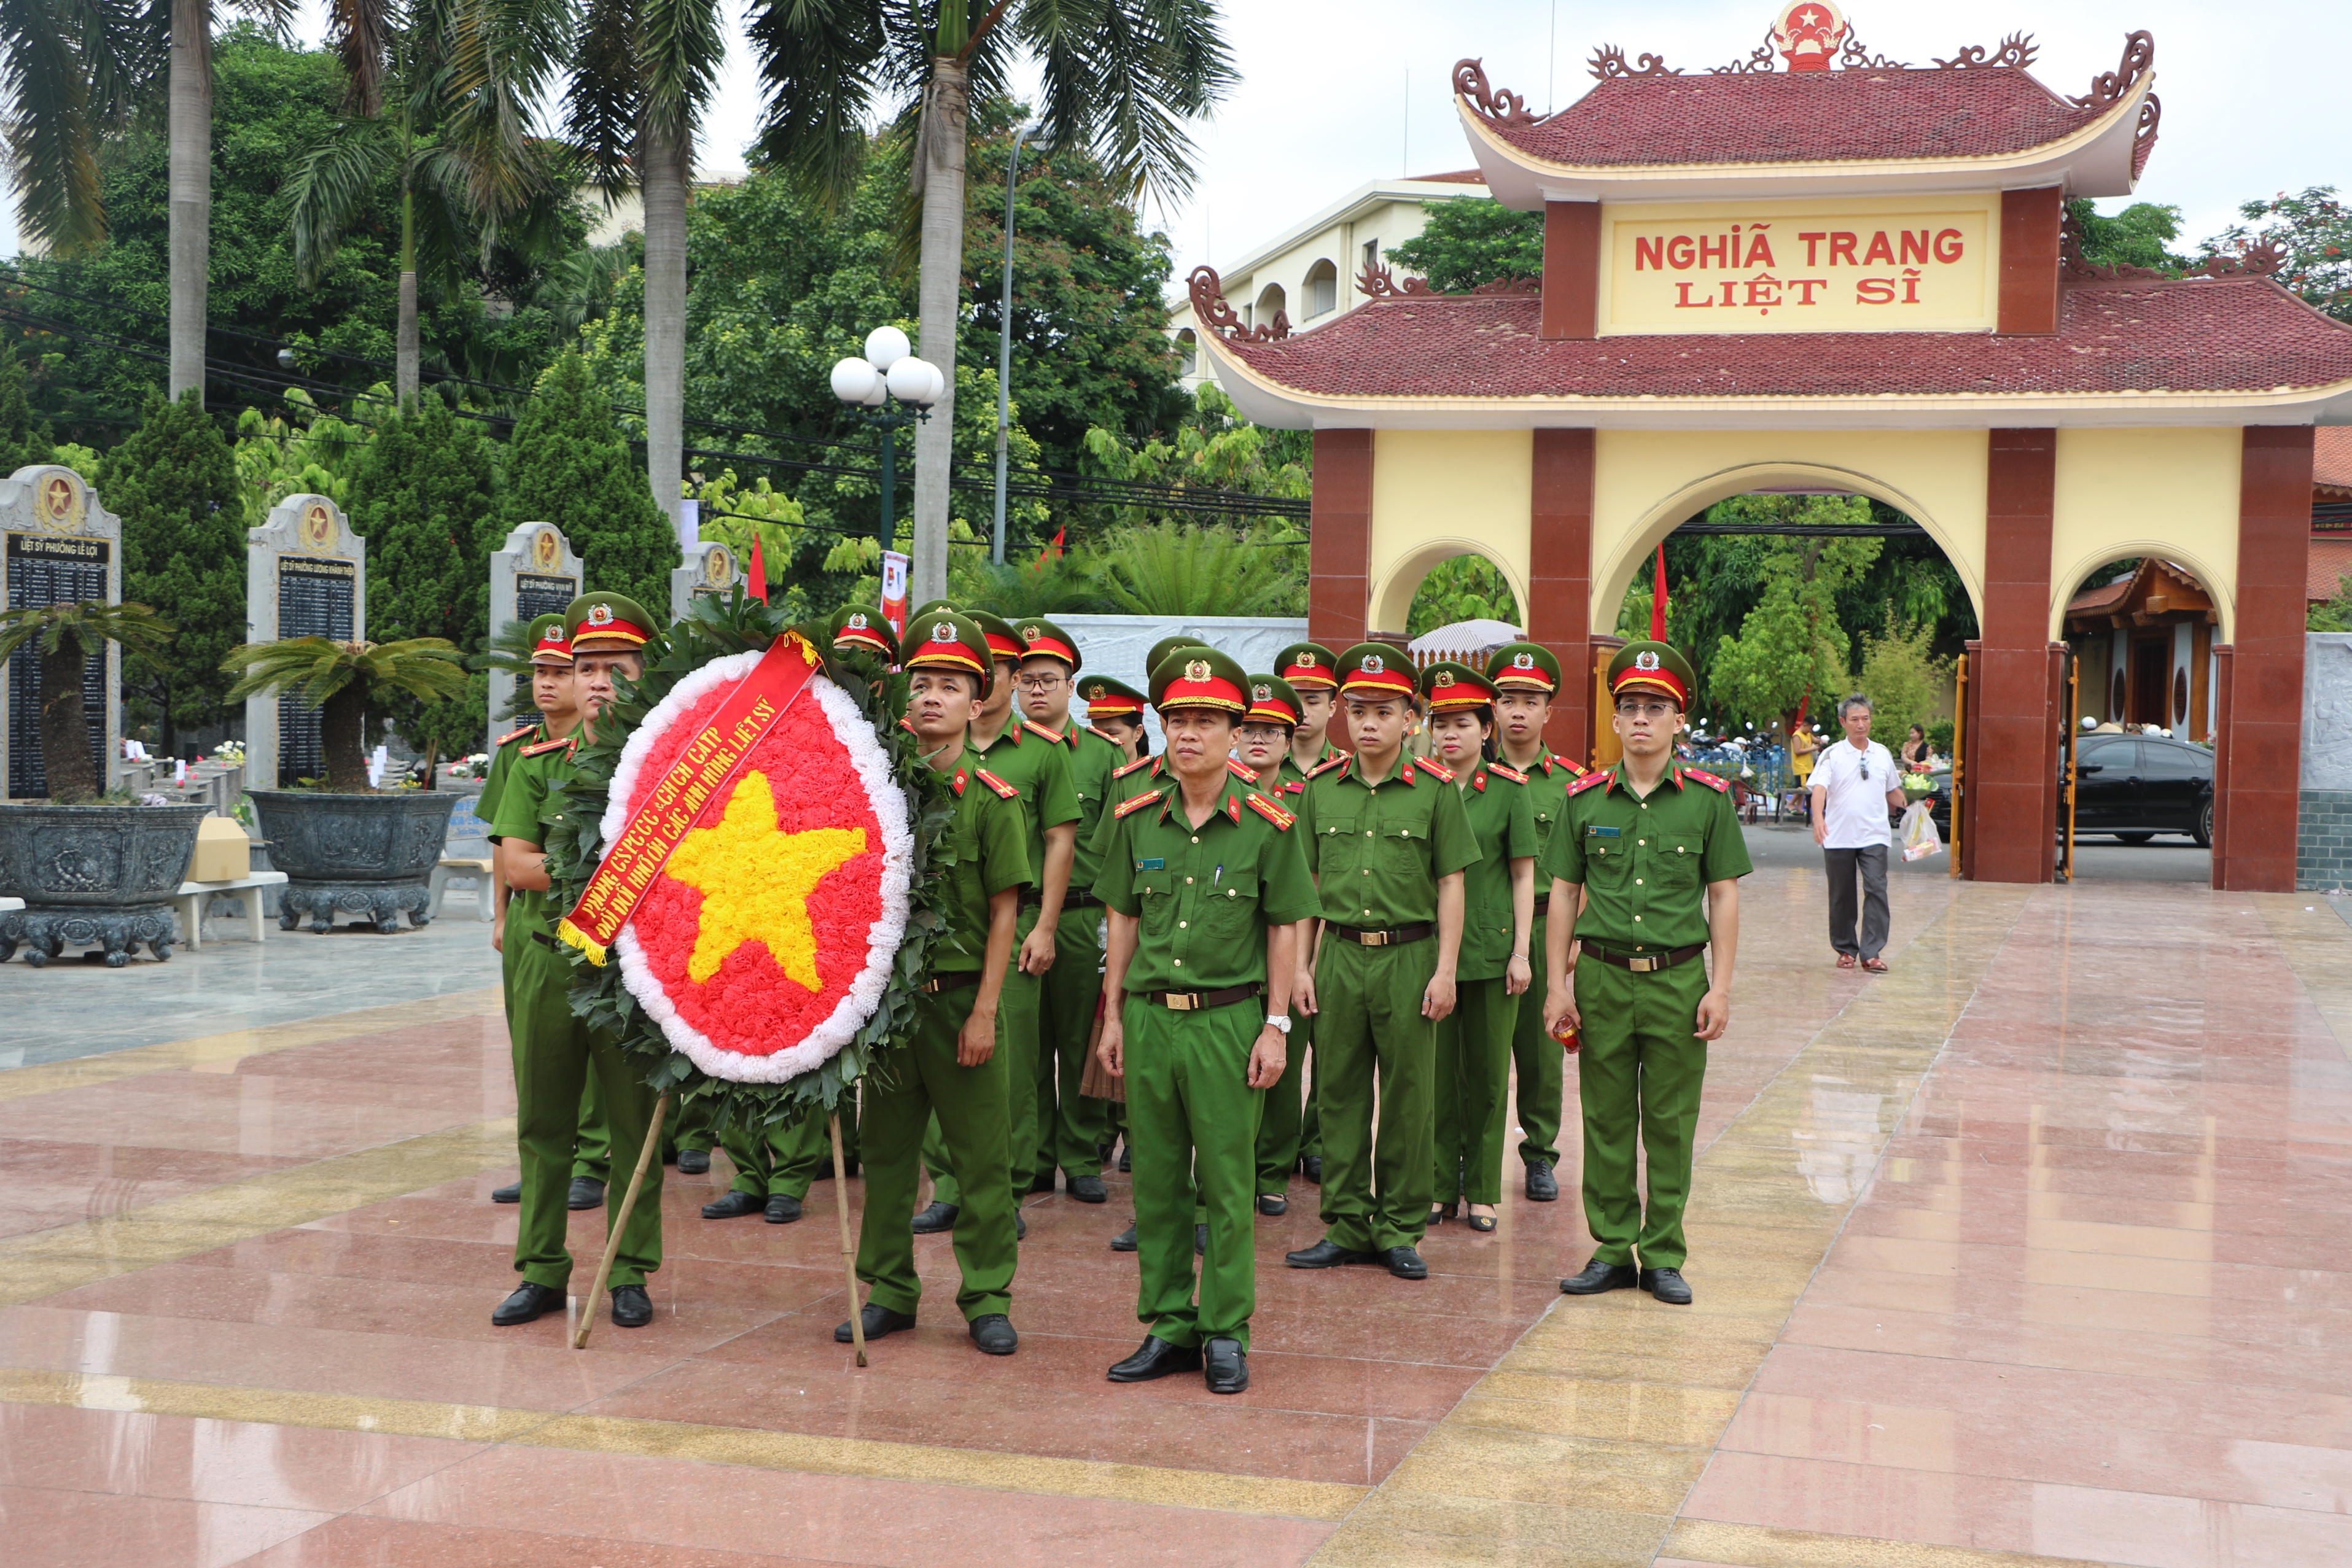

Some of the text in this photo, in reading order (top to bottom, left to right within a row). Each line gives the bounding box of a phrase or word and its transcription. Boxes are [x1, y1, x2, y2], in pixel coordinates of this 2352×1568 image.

[1797, 228, 1965, 266] TRANG
[1674, 267, 1922, 317] LIỆT SĨ
[45, 541, 77, 555] PHƯỜNG
[582, 869, 619, 918] PHÒNG
[610, 809, 660, 872] CSPCCC
[687, 726, 723, 764] CATP
[595, 906, 621, 940] ĐỜI
[610, 882, 637, 916] ĐỜI
[662, 807, 690, 840] CÁC
[682, 780, 711, 815] ANH
[699, 747, 738, 788] HÙNG
[727, 715, 762, 752] LIỆT
